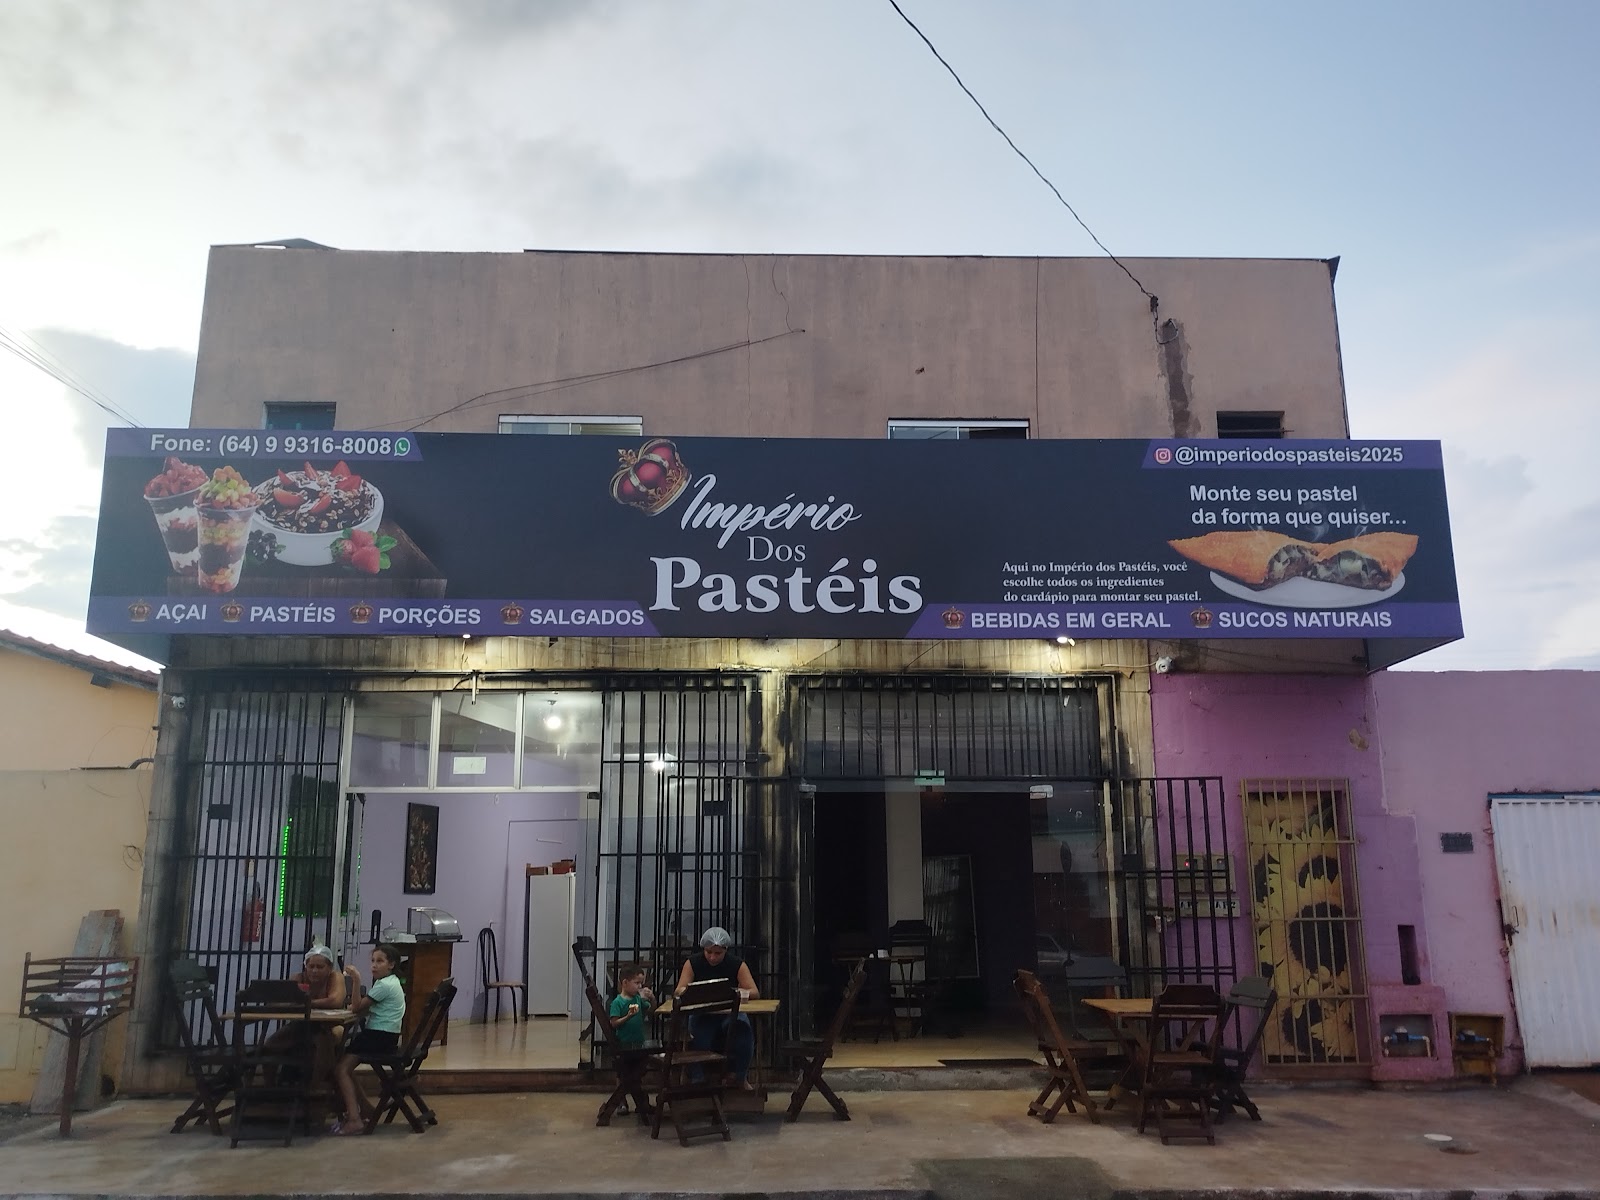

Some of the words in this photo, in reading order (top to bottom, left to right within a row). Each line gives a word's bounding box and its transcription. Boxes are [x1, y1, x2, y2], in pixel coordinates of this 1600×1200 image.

[151, 434, 210, 451] Fone:
[220, 436, 258, 456] (64)
[266, 437, 277, 452] 9
[285, 437, 390, 454] 9316-8008
[1176, 447, 1403, 465] @imperiodospasteis2025
[1190, 486, 1250, 501] Monte
[1257, 489, 1291, 501] seu
[1298, 486, 1357, 504] pastel
[680, 473, 863, 550] Império
[1192, 508, 1216, 524] da
[1221, 508, 1280, 524] forma
[1286, 512, 1322, 528] que
[1327, 509, 1407, 529] quiser...
[748, 536, 805, 561] Dos
[1003, 562, 1028, 574] Aqui
[1050, 562, 1092, 574] Império
[1096, 562, 1115, 571] dos
[1119, 562, 1159, 572] Pastéis,
[1163, 562, 1187, 571] você
[648, 556, 923, 614] Pastéis
[1004, 577, 1043, 586] escolhe
[1047, 577, 1077, 586] todos
[1097, 577, 1164, 589] ingredientes
[1004, 592, 1018, 601] do
[1021, 592, 1069, 604] cardápio
[1073, 594, 1096, 604] para
[1101, 593, 1140, 601] montar
[1166, 591, 1201, 604] pastel.
[156, 604, 206, 623] AÇAI
[250, 603, 335, 622] PASTÉIS
[379, 605, 480, 627] PORÇÕES
[530, 609, 644, 625] SALGADOS
[972, 613, 1059, 628] BEBIDAS
[1066, 613, 1095, 627] EM
[1102, 613, 1170, 627] GERAL
[1219, 612, 1287, 627] SUCOS
[1294, 612, 1391, 627] NATURAIS
